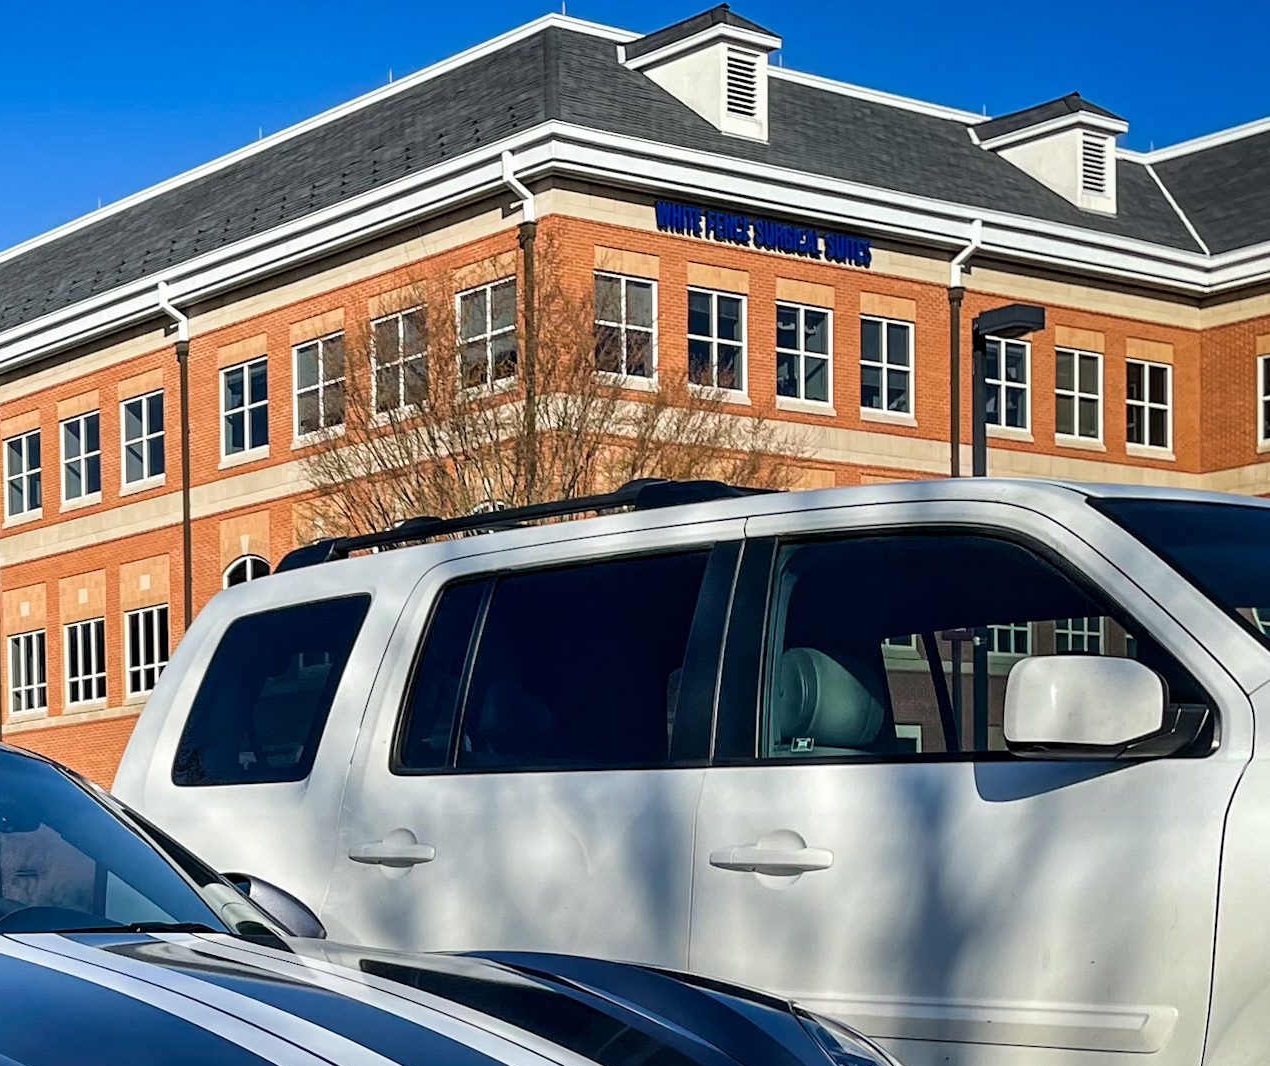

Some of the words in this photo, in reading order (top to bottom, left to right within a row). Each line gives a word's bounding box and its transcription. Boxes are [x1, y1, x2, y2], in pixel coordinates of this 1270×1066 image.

[655, 200, 702, 234] WHITE
[706, 209, 750, 243] FENCE
[753, 219, 822, 255] SURGICAL
[824, 233, 872, 266] SUITES
